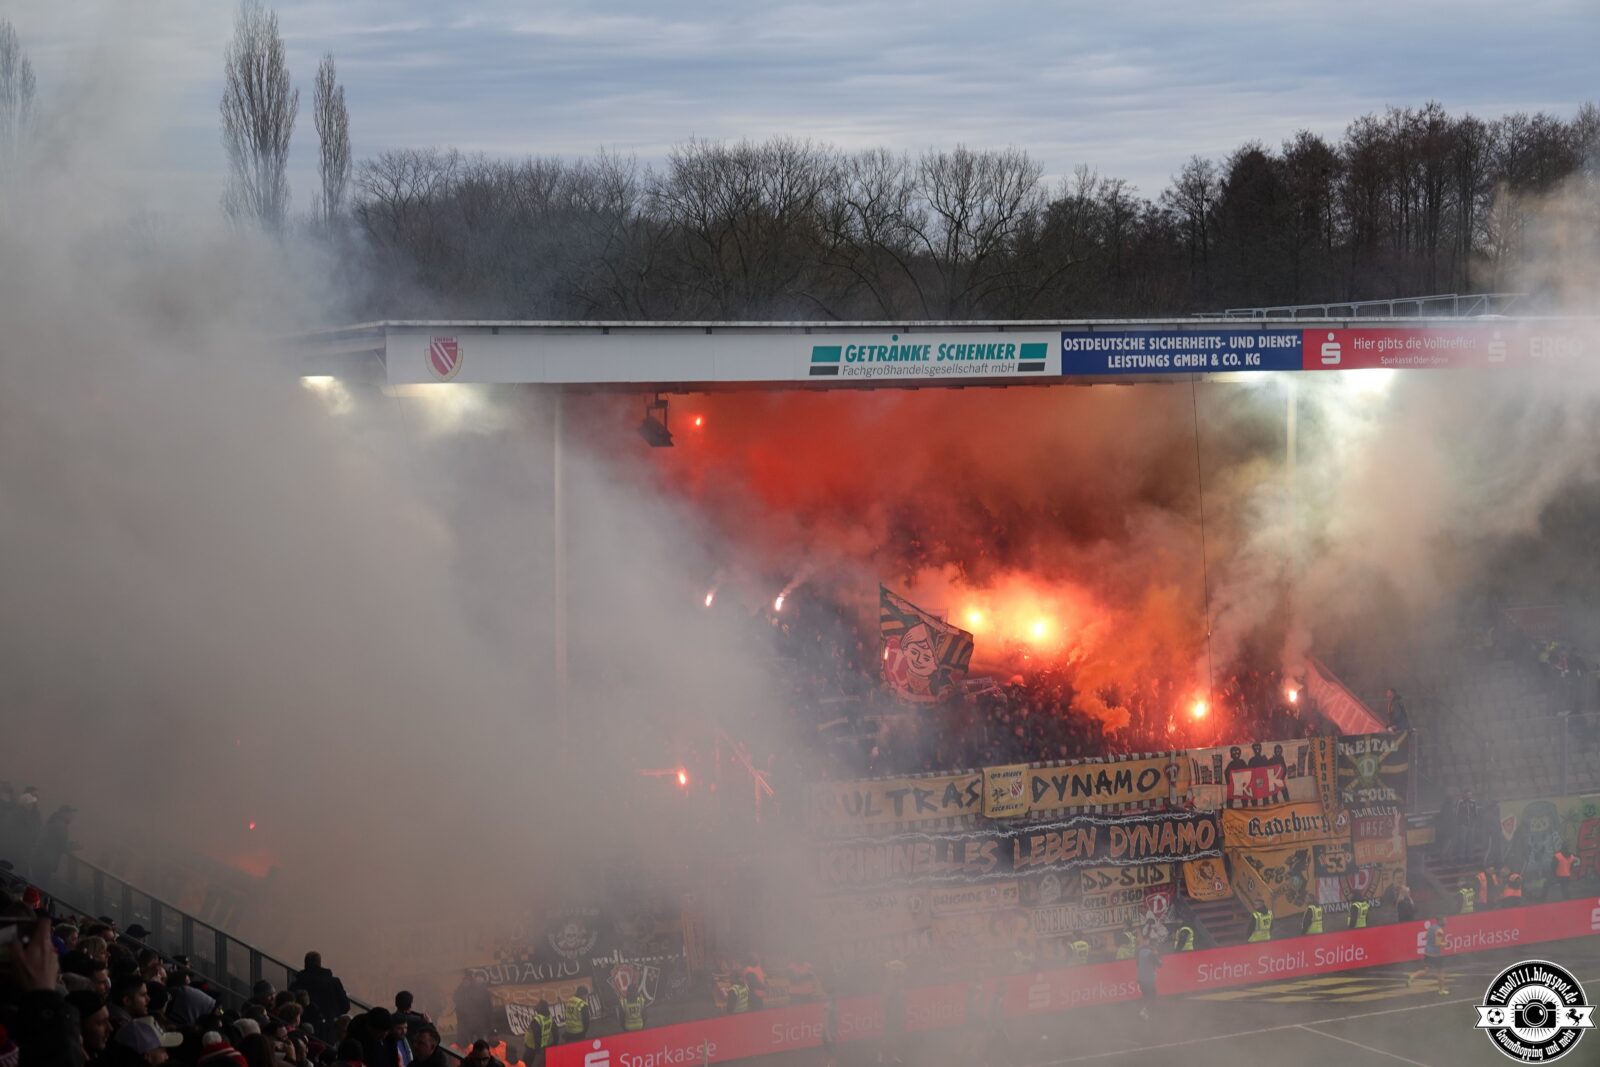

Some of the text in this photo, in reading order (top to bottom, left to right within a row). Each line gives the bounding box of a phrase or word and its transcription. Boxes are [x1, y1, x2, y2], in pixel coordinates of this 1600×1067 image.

[936, 343, 1016, 362] SCHENKER
[1063, 335, 1302, 352] OSTDEUTSCHE SICHERHEITS- UND DIENST-
[1353, 336, 1476, 352] Hier gibts die Volltreffer!
[842, 362, 1016, 378] Fachgroßhandelsgesellschaft mbH
[1107, 352, 1261, 369] LEISTUNGS GMBH & CO. KG
[1380, 355, 1413, 367] Sparkasse
[1031, 767, 1161, 803] DYNAMO
[842, 778, 982, 818] ULTRAS
[1013, 827, 1097, 870] LEBEN
[1109, 820, 1216, 859] DYNAMO
[1444, 926, 1520, 954] Sparkasse
[1196, 944, 1369, 983] Sicher. Stabil. Solide.
[619, 1040, 717, 1067] Sparkasse
